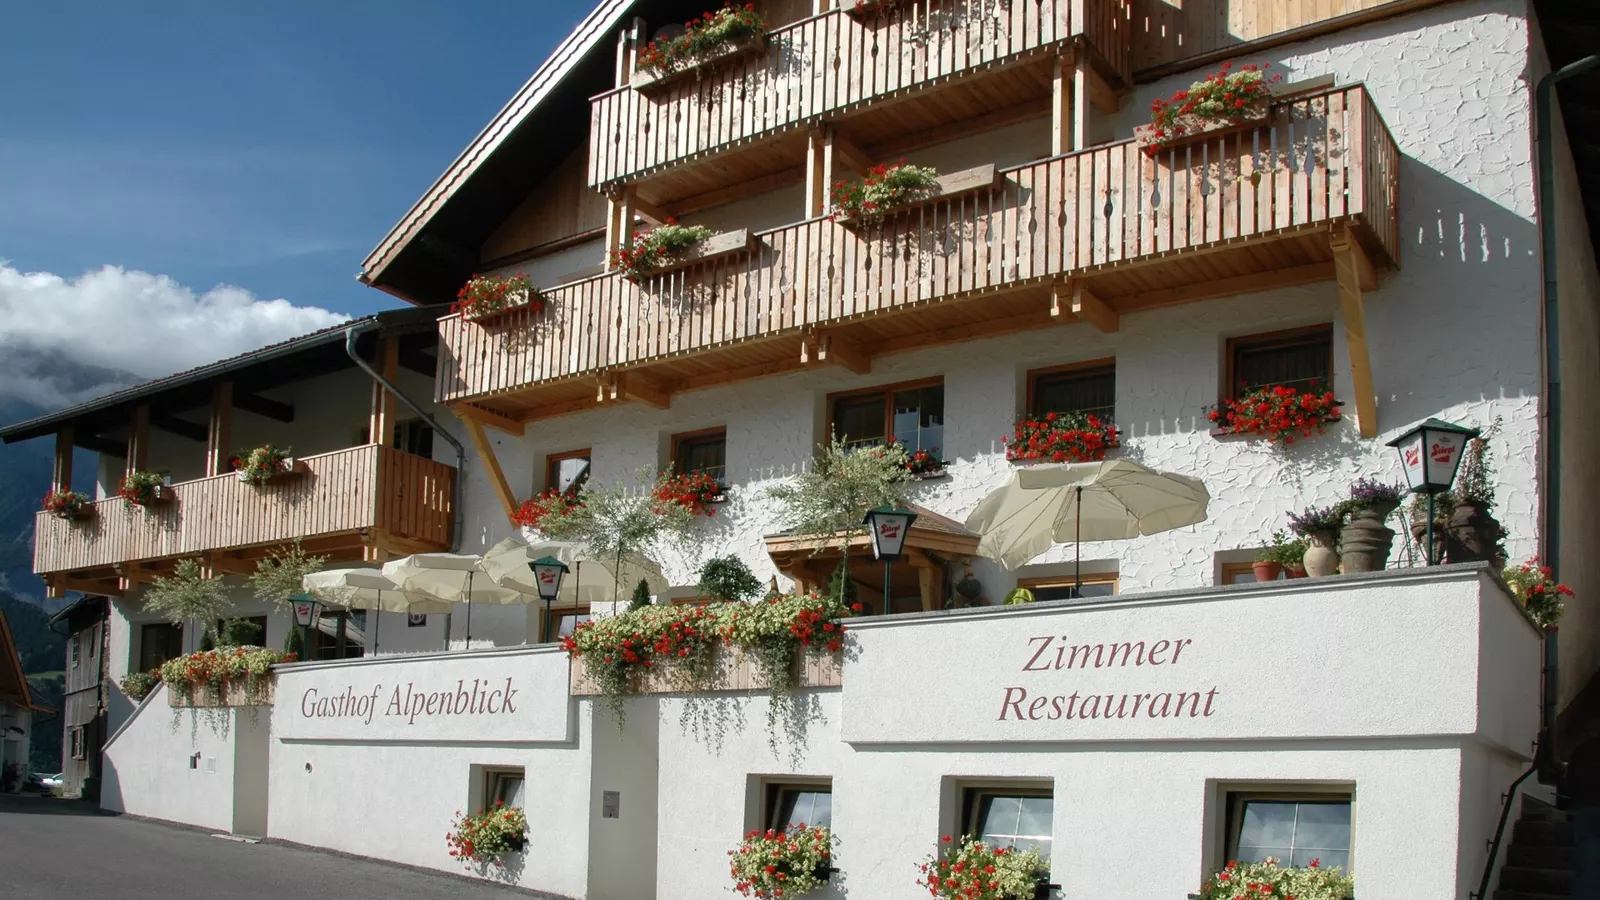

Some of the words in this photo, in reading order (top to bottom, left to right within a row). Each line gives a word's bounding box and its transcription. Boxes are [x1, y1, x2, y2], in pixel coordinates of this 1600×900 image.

[1021, 635, 1192, 672] Zimmer
[301, 683, 382, 725] Gasthof
[385, 676, 519, 725] Alpenblick
[996, 685, 1220, 721] Restaurant
